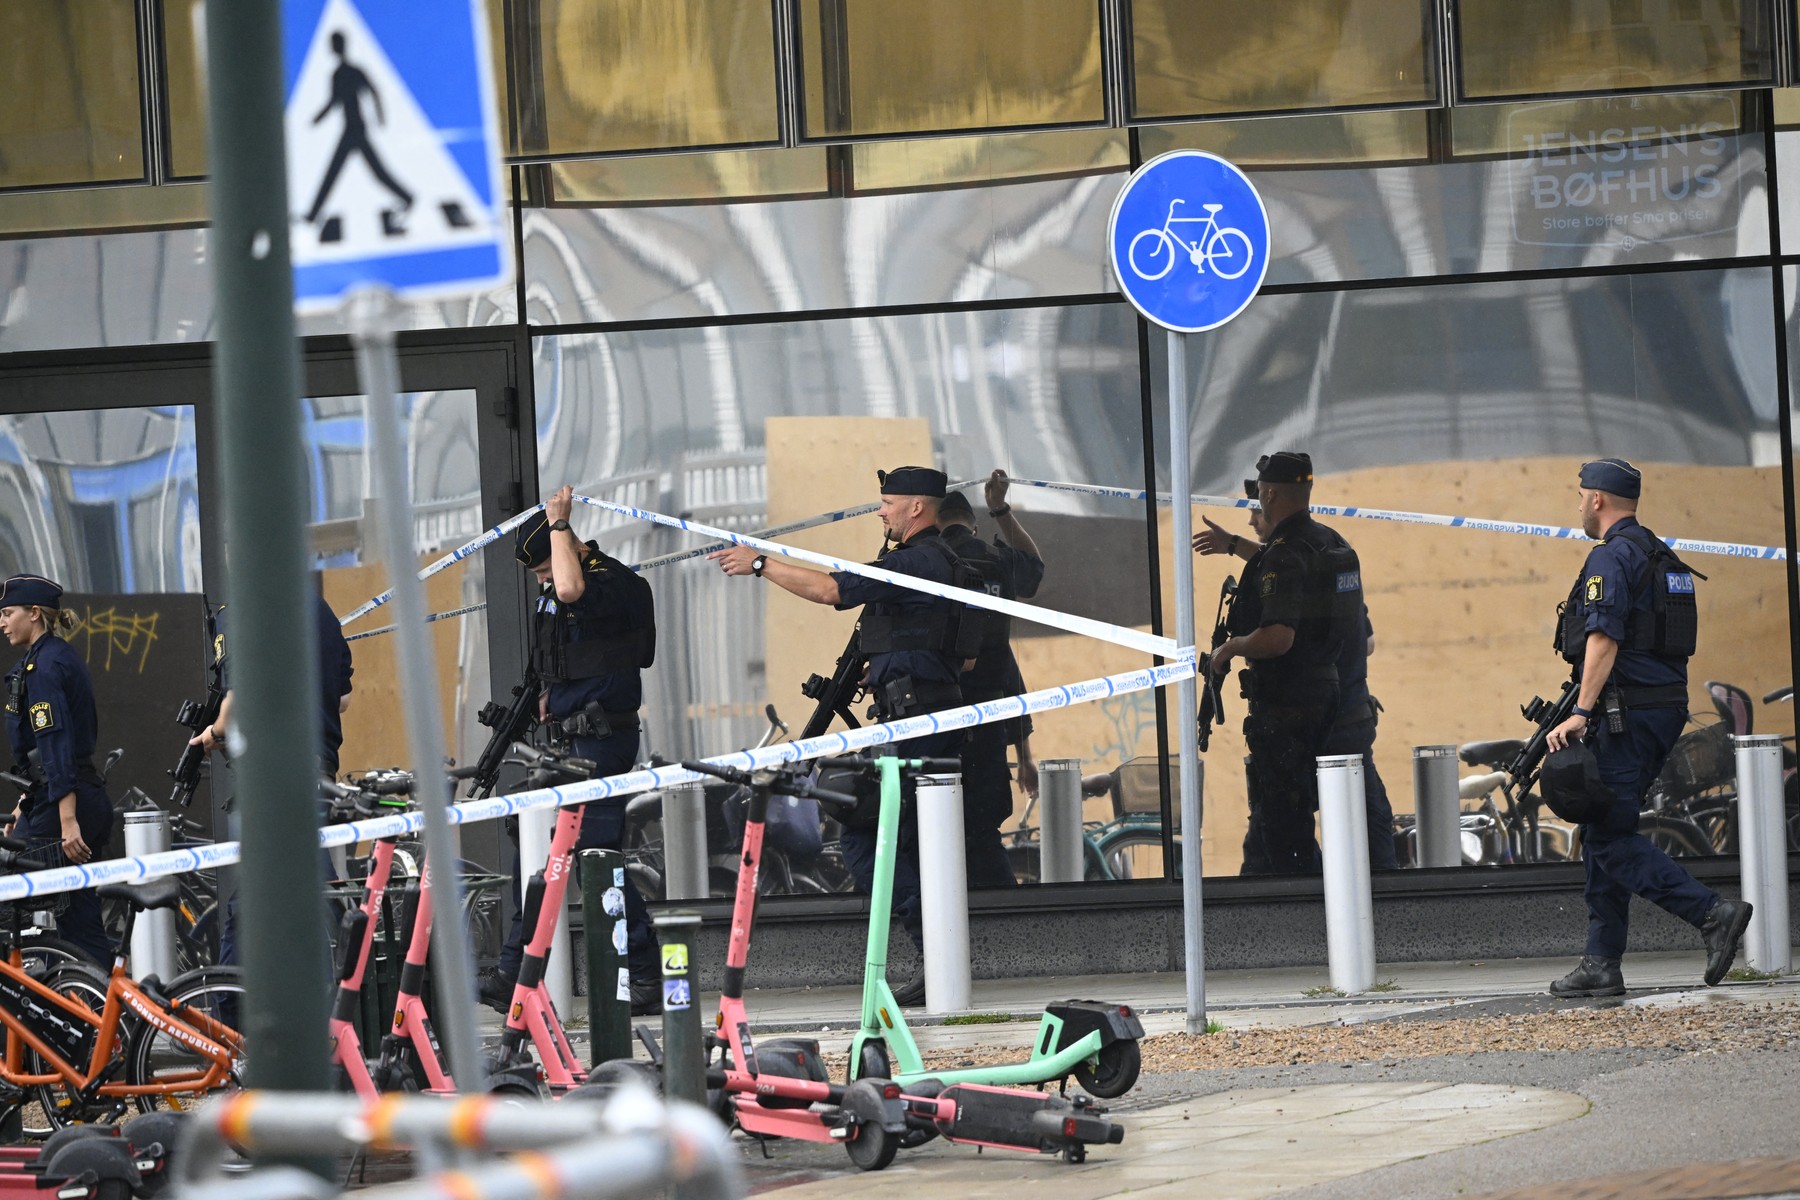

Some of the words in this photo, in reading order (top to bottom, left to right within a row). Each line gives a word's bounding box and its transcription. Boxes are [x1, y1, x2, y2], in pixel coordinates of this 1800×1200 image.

[1521, 121, 1726, 168] JENSEN'S
[1530, 163, 1722, 210] BØFHUS
[1542, 217, 1580, 230] Store
[1669, 208, 1709, 222] priser
[1668, 575, 1693, 591] POLIS
[1070, 684, 1086, 698] POLIS
[31, 703, 48, 714] POLIS
[131, 998, 167, 1029] DONKEY
[168, 1025, 220, 1056] REPUBLIC
